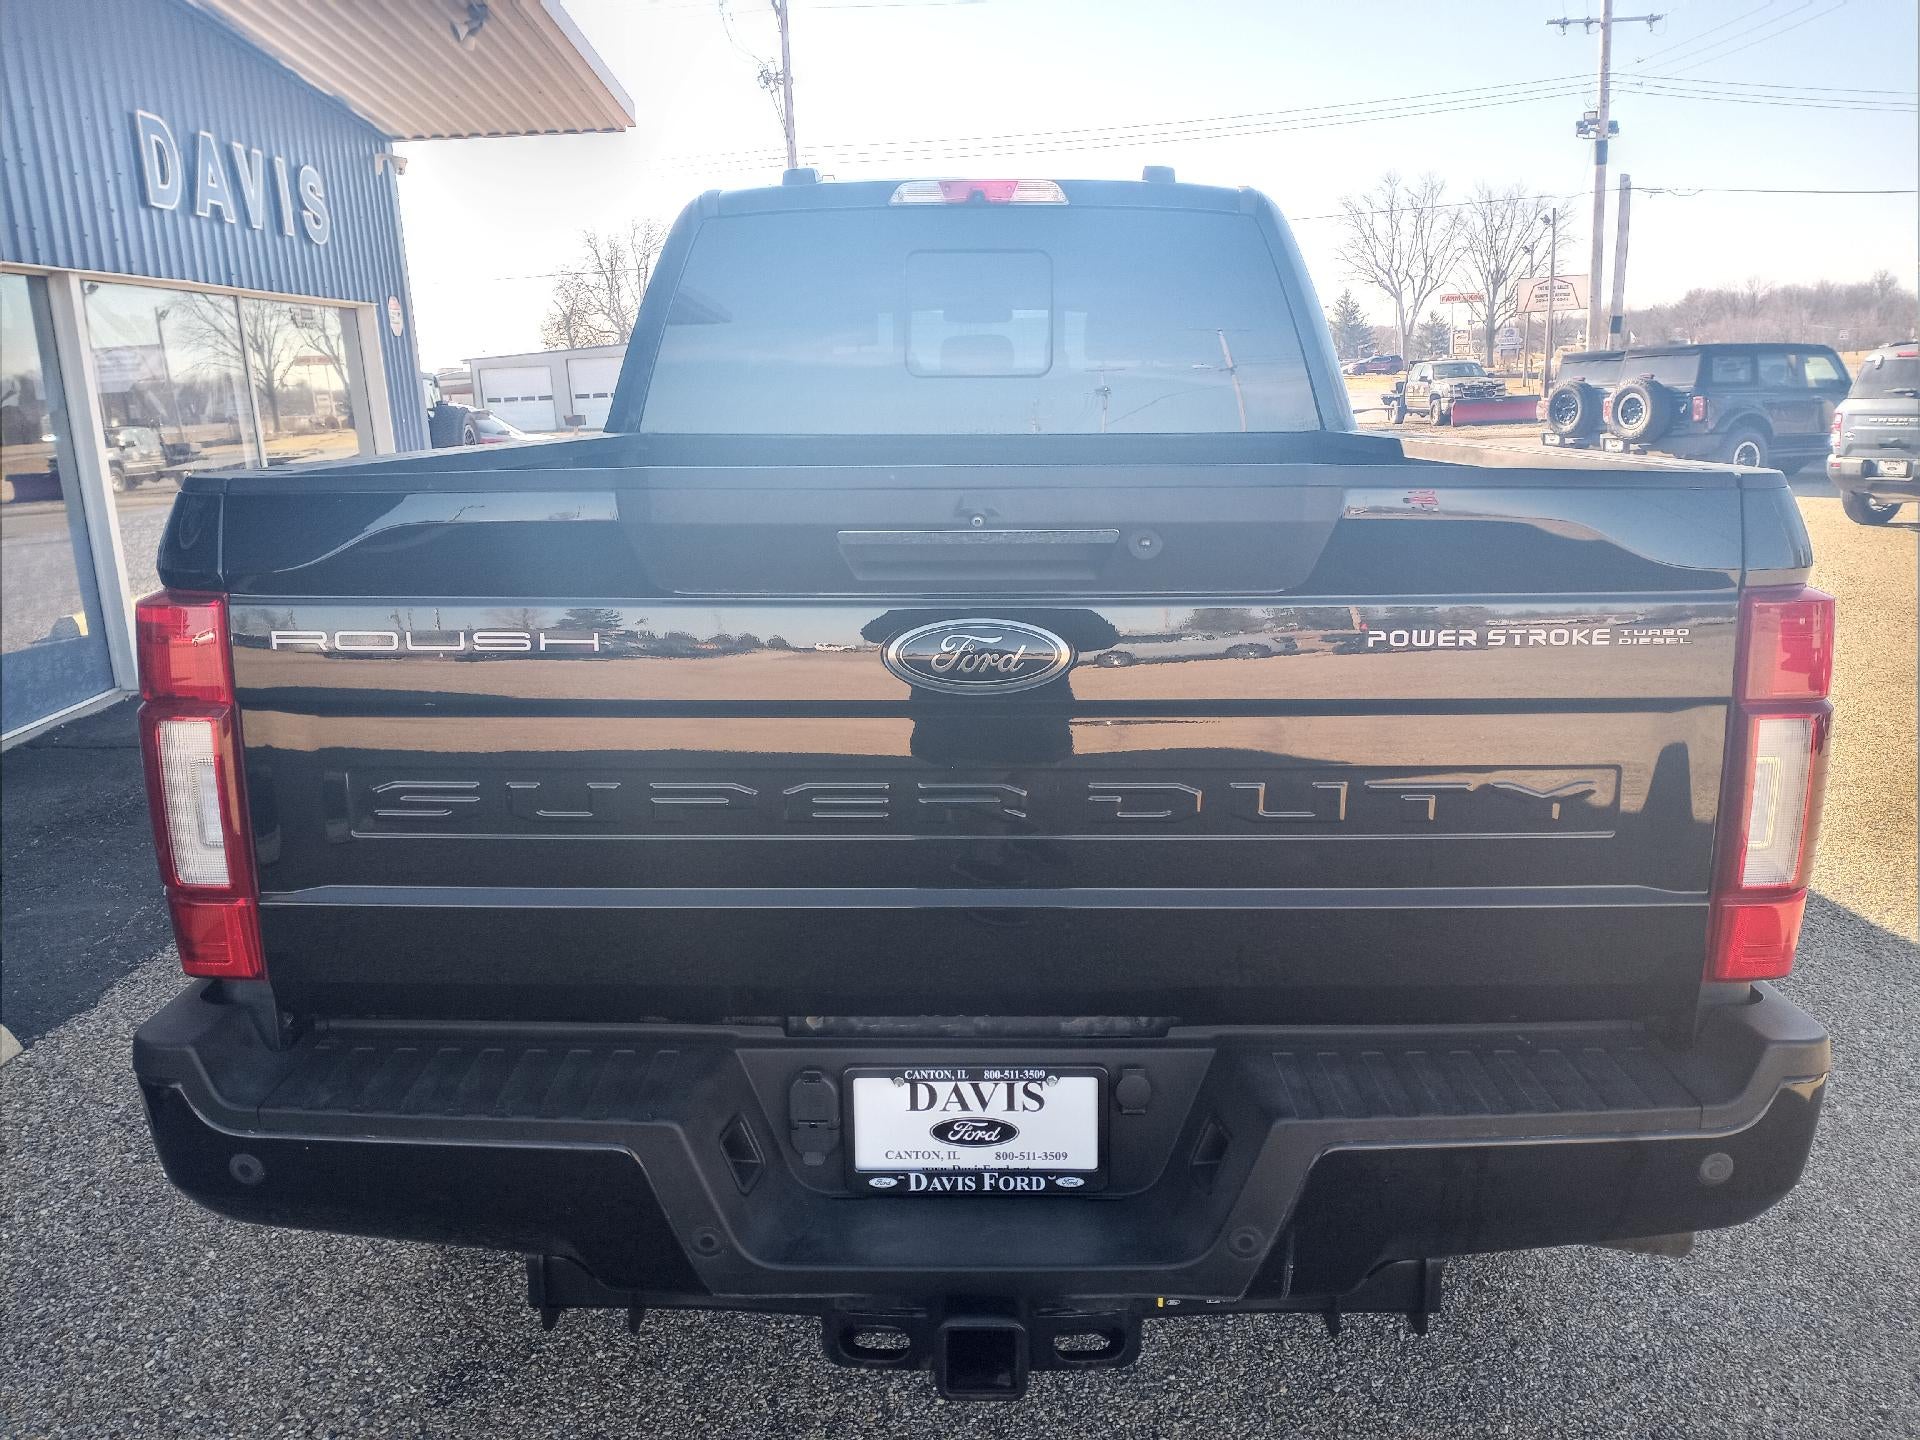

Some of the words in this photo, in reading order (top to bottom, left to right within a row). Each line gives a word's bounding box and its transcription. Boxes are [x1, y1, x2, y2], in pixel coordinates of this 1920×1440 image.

[136, 109, 331, 246] DAVIS
[269, 630, 600, 652] ROUSH
[1367, 628, 1478, 648] POWER
[1487, 627, 1612, 647] STROKE
[1617, 637, 1694, 646] DIESEL
[1618, 627, 1691, 636] TURBO
[930, 633, 1028, 674] Ford
[371, 779, 1028, 823] SUPER
[1087, 779, 1598, 823] DUTY
[904, 1069, 955, 1081] CANTON,
[957, 1069, 969, 1079] IL
[983, 1069, 1046, 1080] 800-511-3509
[905, 1081, 1047, 1113] DAVIS
[947, 1119, 1002, 1144] Ford
[884, 1150, 944, 1162] CANTON,
[947, 1150, 960, 1160] IL
[994, 1151, 1068, 1161] 800-511-3509
[907, 1172, 976, 1192] DAVIS
[981, 1172, 1047, 1191] FORD
